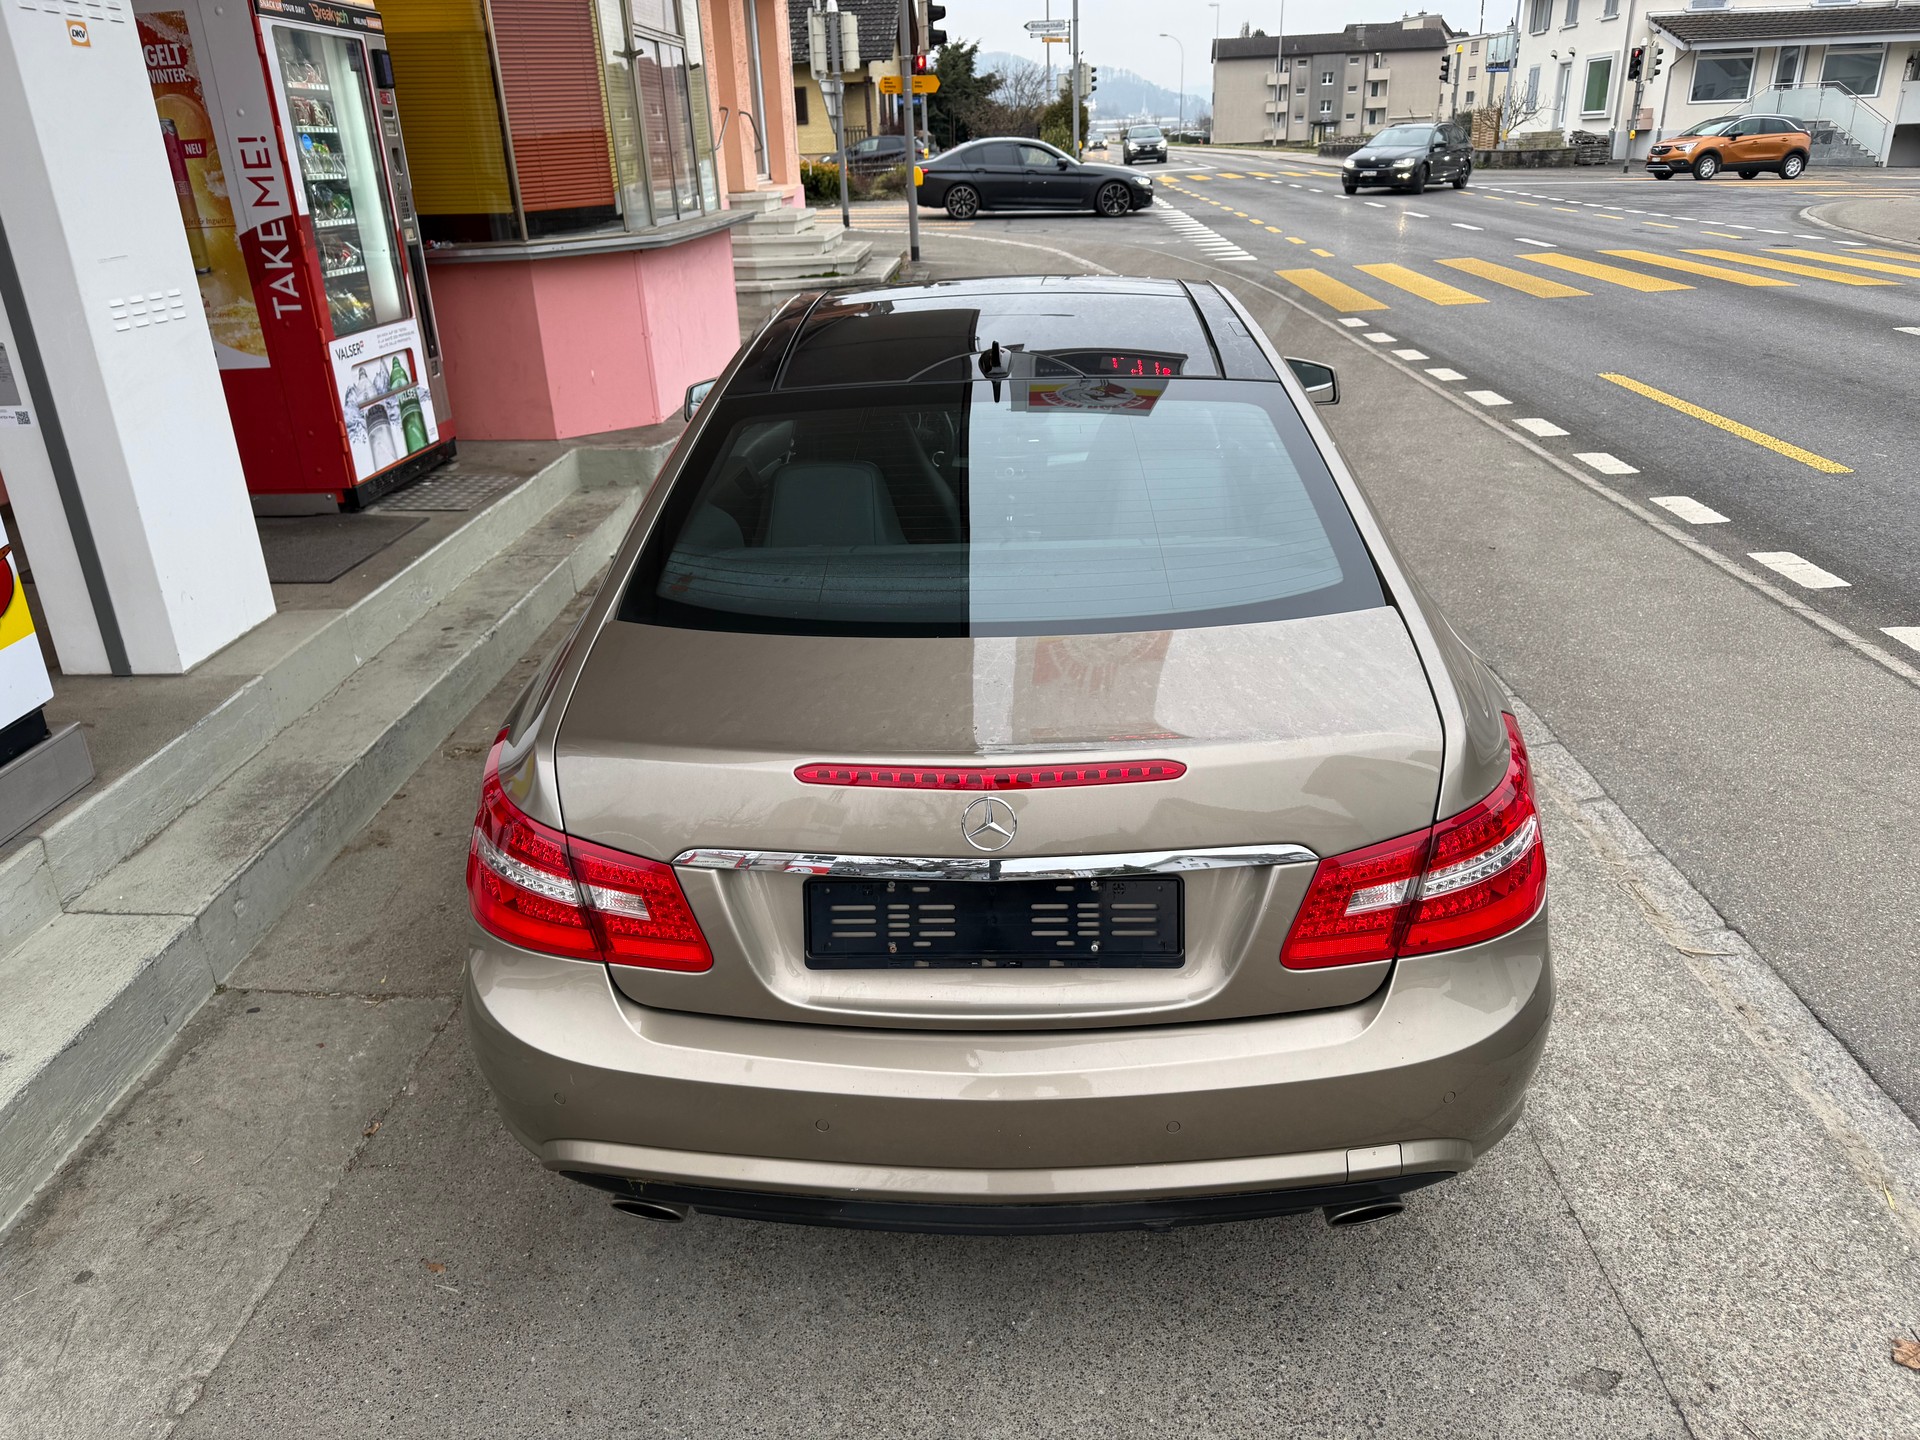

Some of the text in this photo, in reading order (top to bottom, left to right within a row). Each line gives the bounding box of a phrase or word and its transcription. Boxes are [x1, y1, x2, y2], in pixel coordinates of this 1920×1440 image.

[72, 29, 85, 38] DKV
[143, 43, 181, 67] GELT
[184, 143, 203, 155] NEU
[237, 135, 303, 319] TAKE ME!
[335, 342, 363, 360] VALSER
